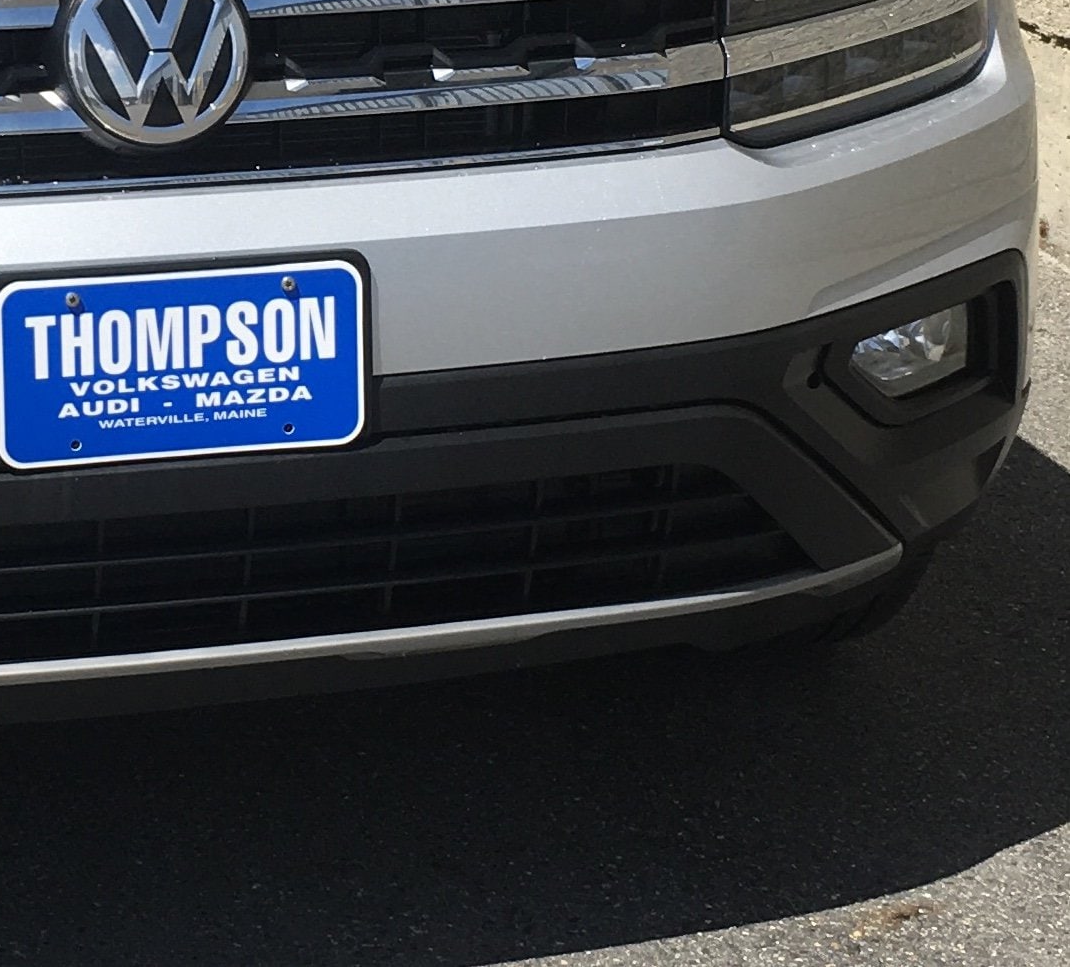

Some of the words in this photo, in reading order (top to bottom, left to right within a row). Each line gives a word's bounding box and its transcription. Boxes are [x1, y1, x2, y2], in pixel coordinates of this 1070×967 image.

[24, 295, 336, 380] THOMPSON
[69, 366, 300, 397] VOLKSWAGEN
[58, 397, 140, 419] AUDI
[195, 385, 313, 408] MAZDA
[98, 415, 210, 429] WATERVILLE,
[212, 407, 267, 421] MAINE
